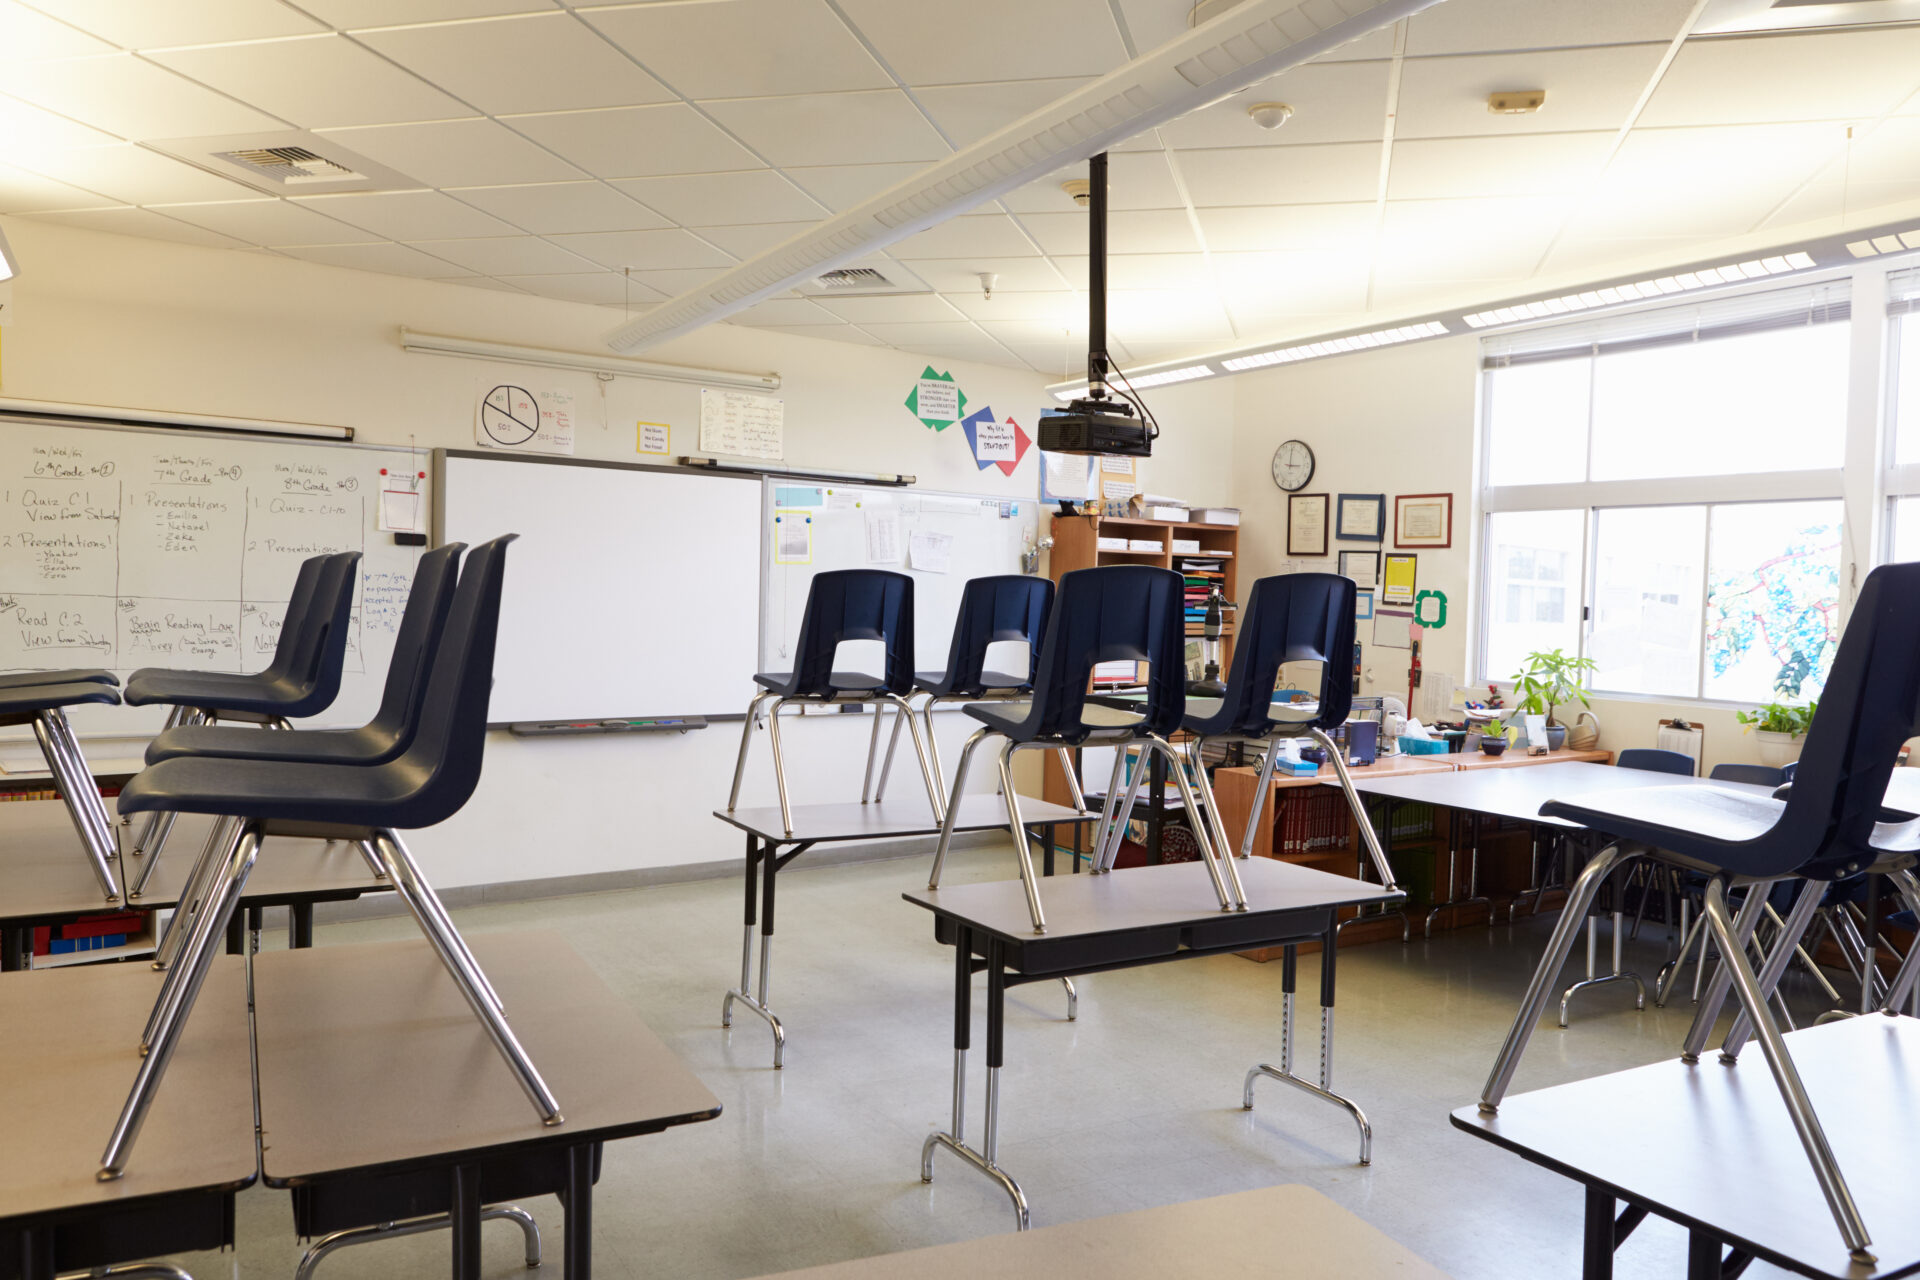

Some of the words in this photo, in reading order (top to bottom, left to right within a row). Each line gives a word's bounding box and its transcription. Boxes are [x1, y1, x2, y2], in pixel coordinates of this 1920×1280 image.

[54, 464, 86, 477] Grade
[179, 469, 212, 484] Grade
[302, 479, 332, 493] Grade
[22, 489, 59, 507] Quiz
[145, 491, 228, 512] Presentations
[269, 498, 305, 514] Quiz
[25, 508, 57, 522] View
[165, 541, 198, 552] Eden
[16, 606, 49, 627] Read
[259, 612, 281, 628] Rea
[164, 613, 207, 637] Reading
[21, 630, 53, 648] View
